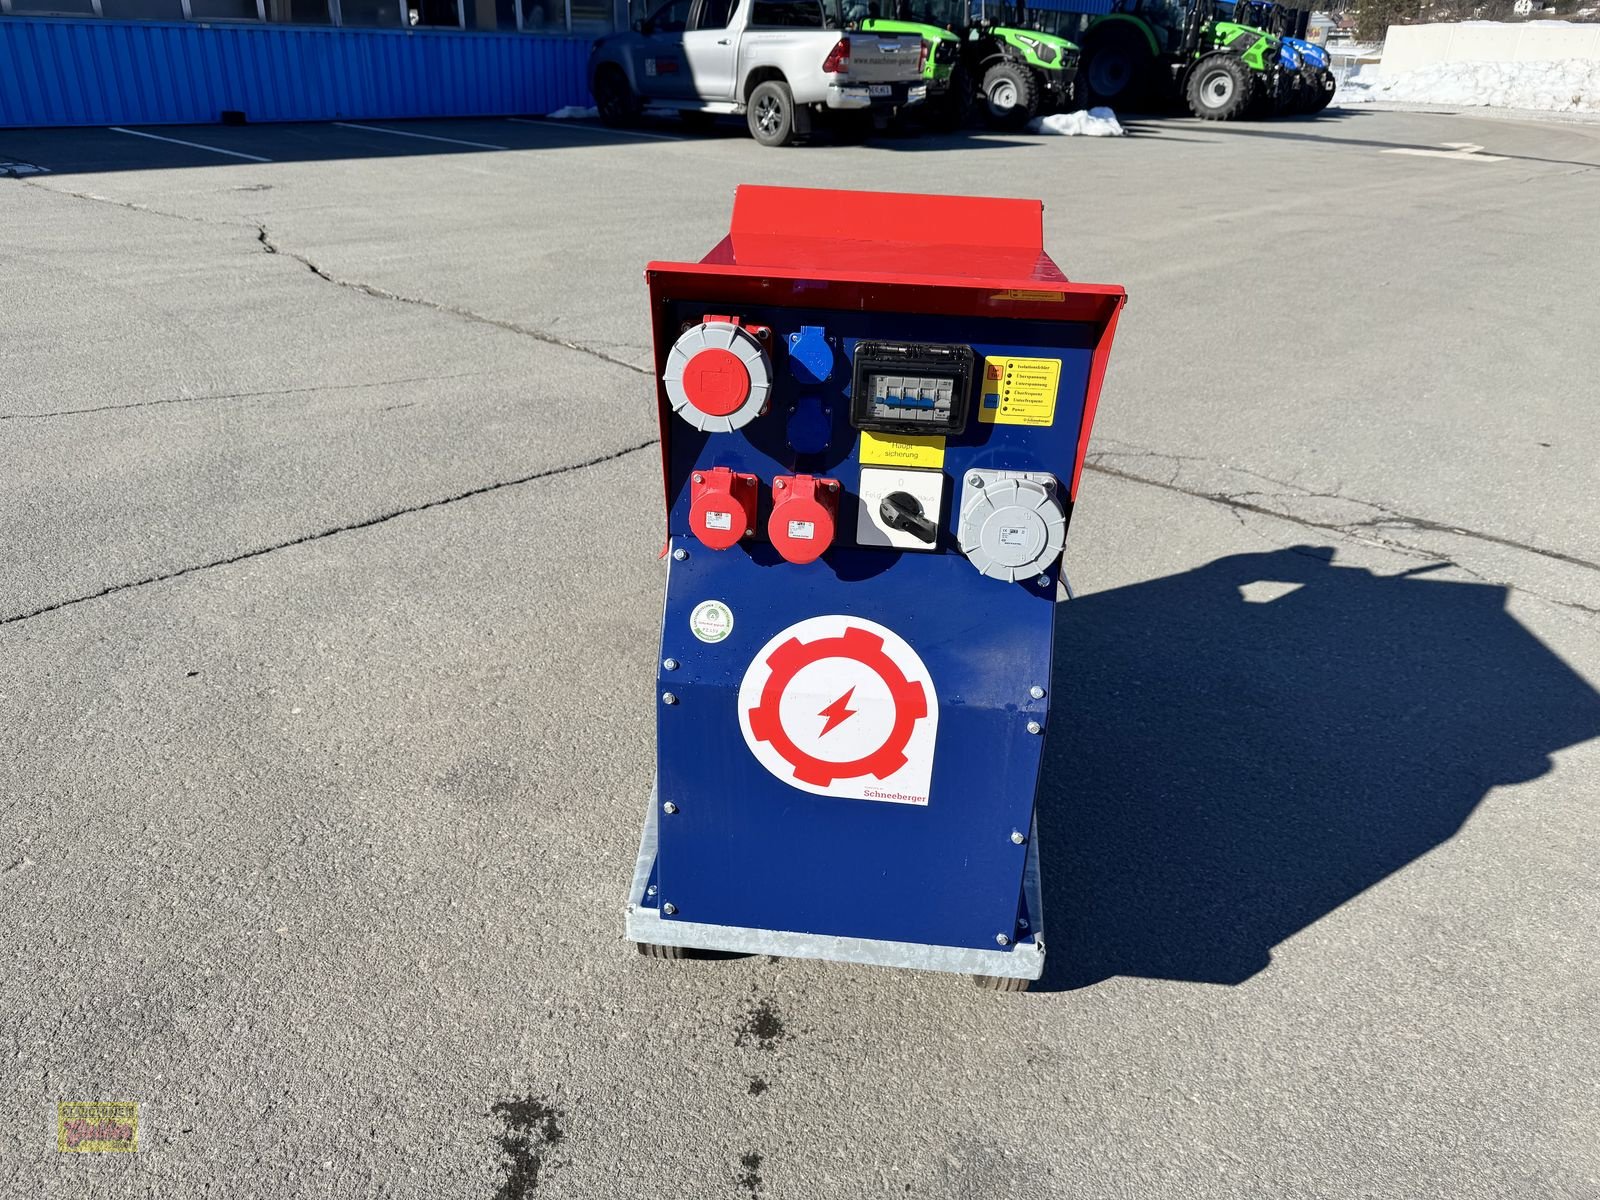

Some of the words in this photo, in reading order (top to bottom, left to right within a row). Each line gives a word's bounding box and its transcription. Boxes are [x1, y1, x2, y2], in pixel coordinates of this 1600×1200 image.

[891, 441, 913, 450] Haupt
[884, 449, 919, 459] sicherung
[863, 789, 927, 803] Schneeberger
